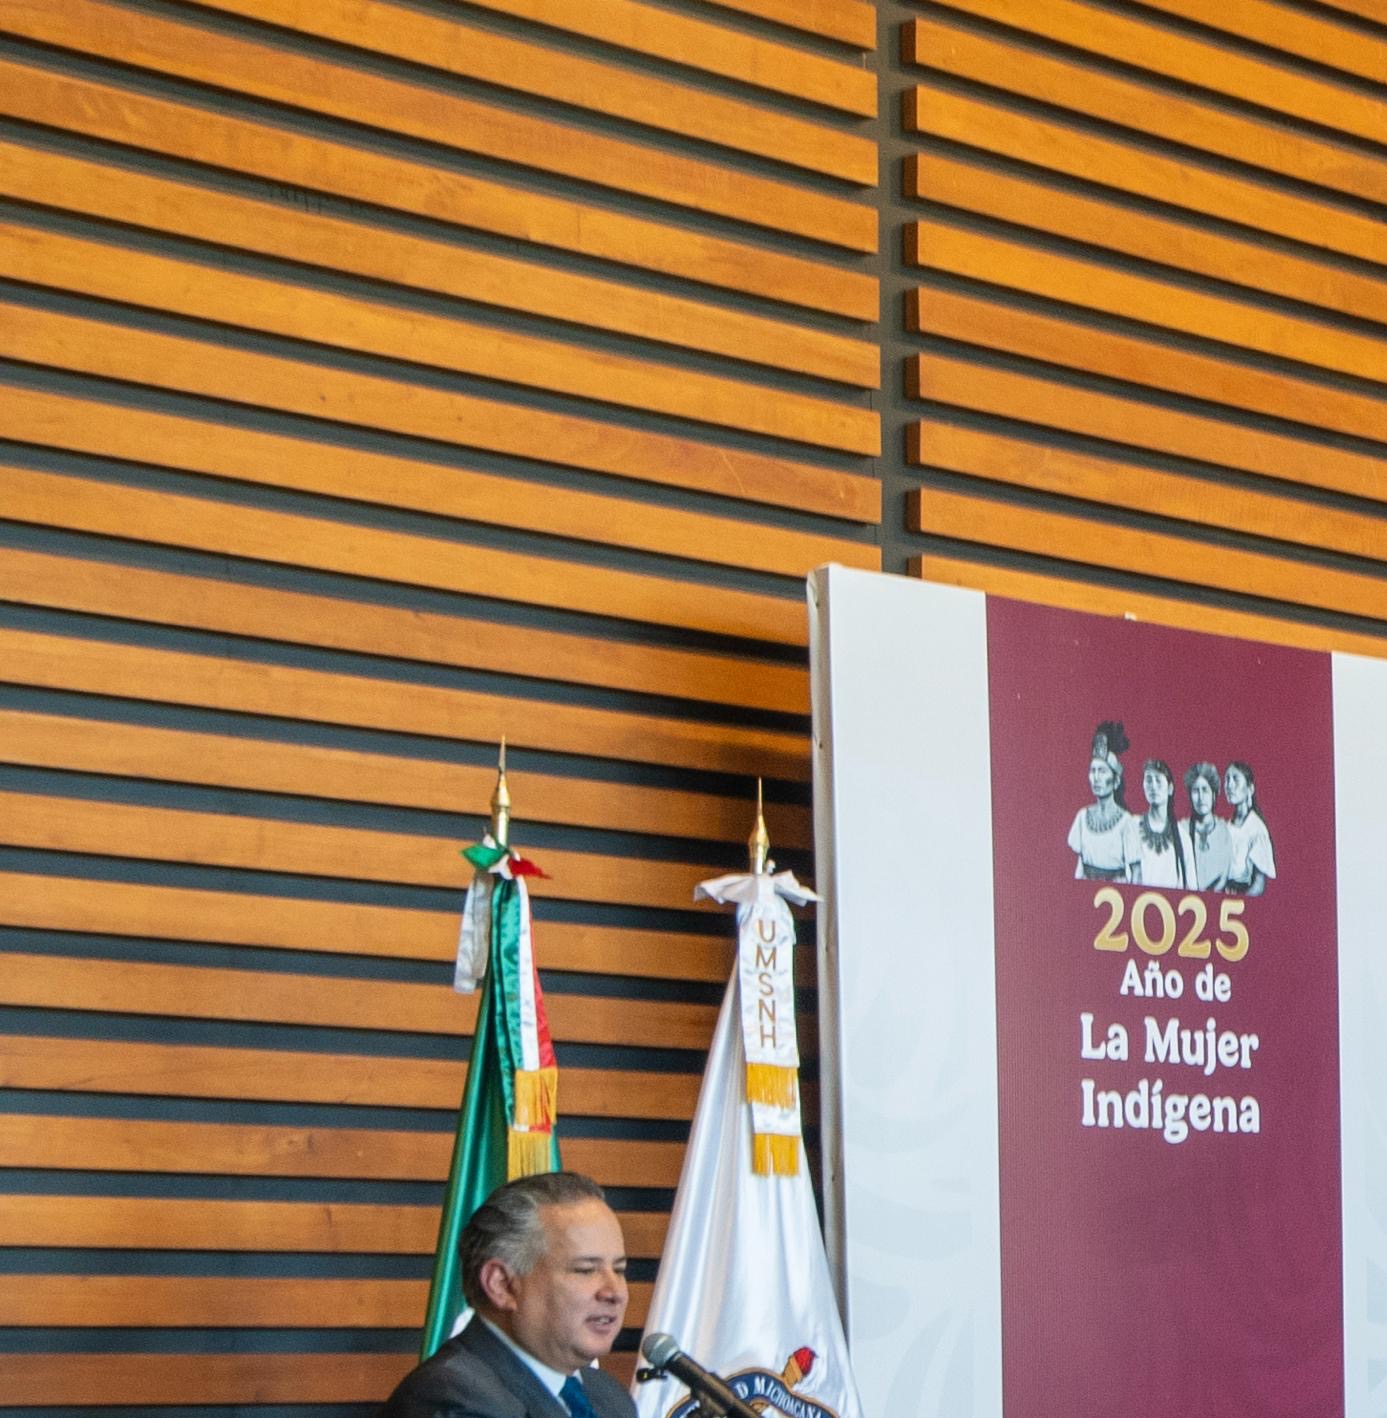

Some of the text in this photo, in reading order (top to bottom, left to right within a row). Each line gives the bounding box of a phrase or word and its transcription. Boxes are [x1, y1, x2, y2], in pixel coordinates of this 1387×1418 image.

[1093, 887, 1250, 961] 2025
[755, 919, 777, 1049] UMSNH
[1120, 959, 1232, 1002] Año de
[1080, 1013, 1260, 1076] La Mujer
[1081, 1077, 1260, 1144] Indígena
